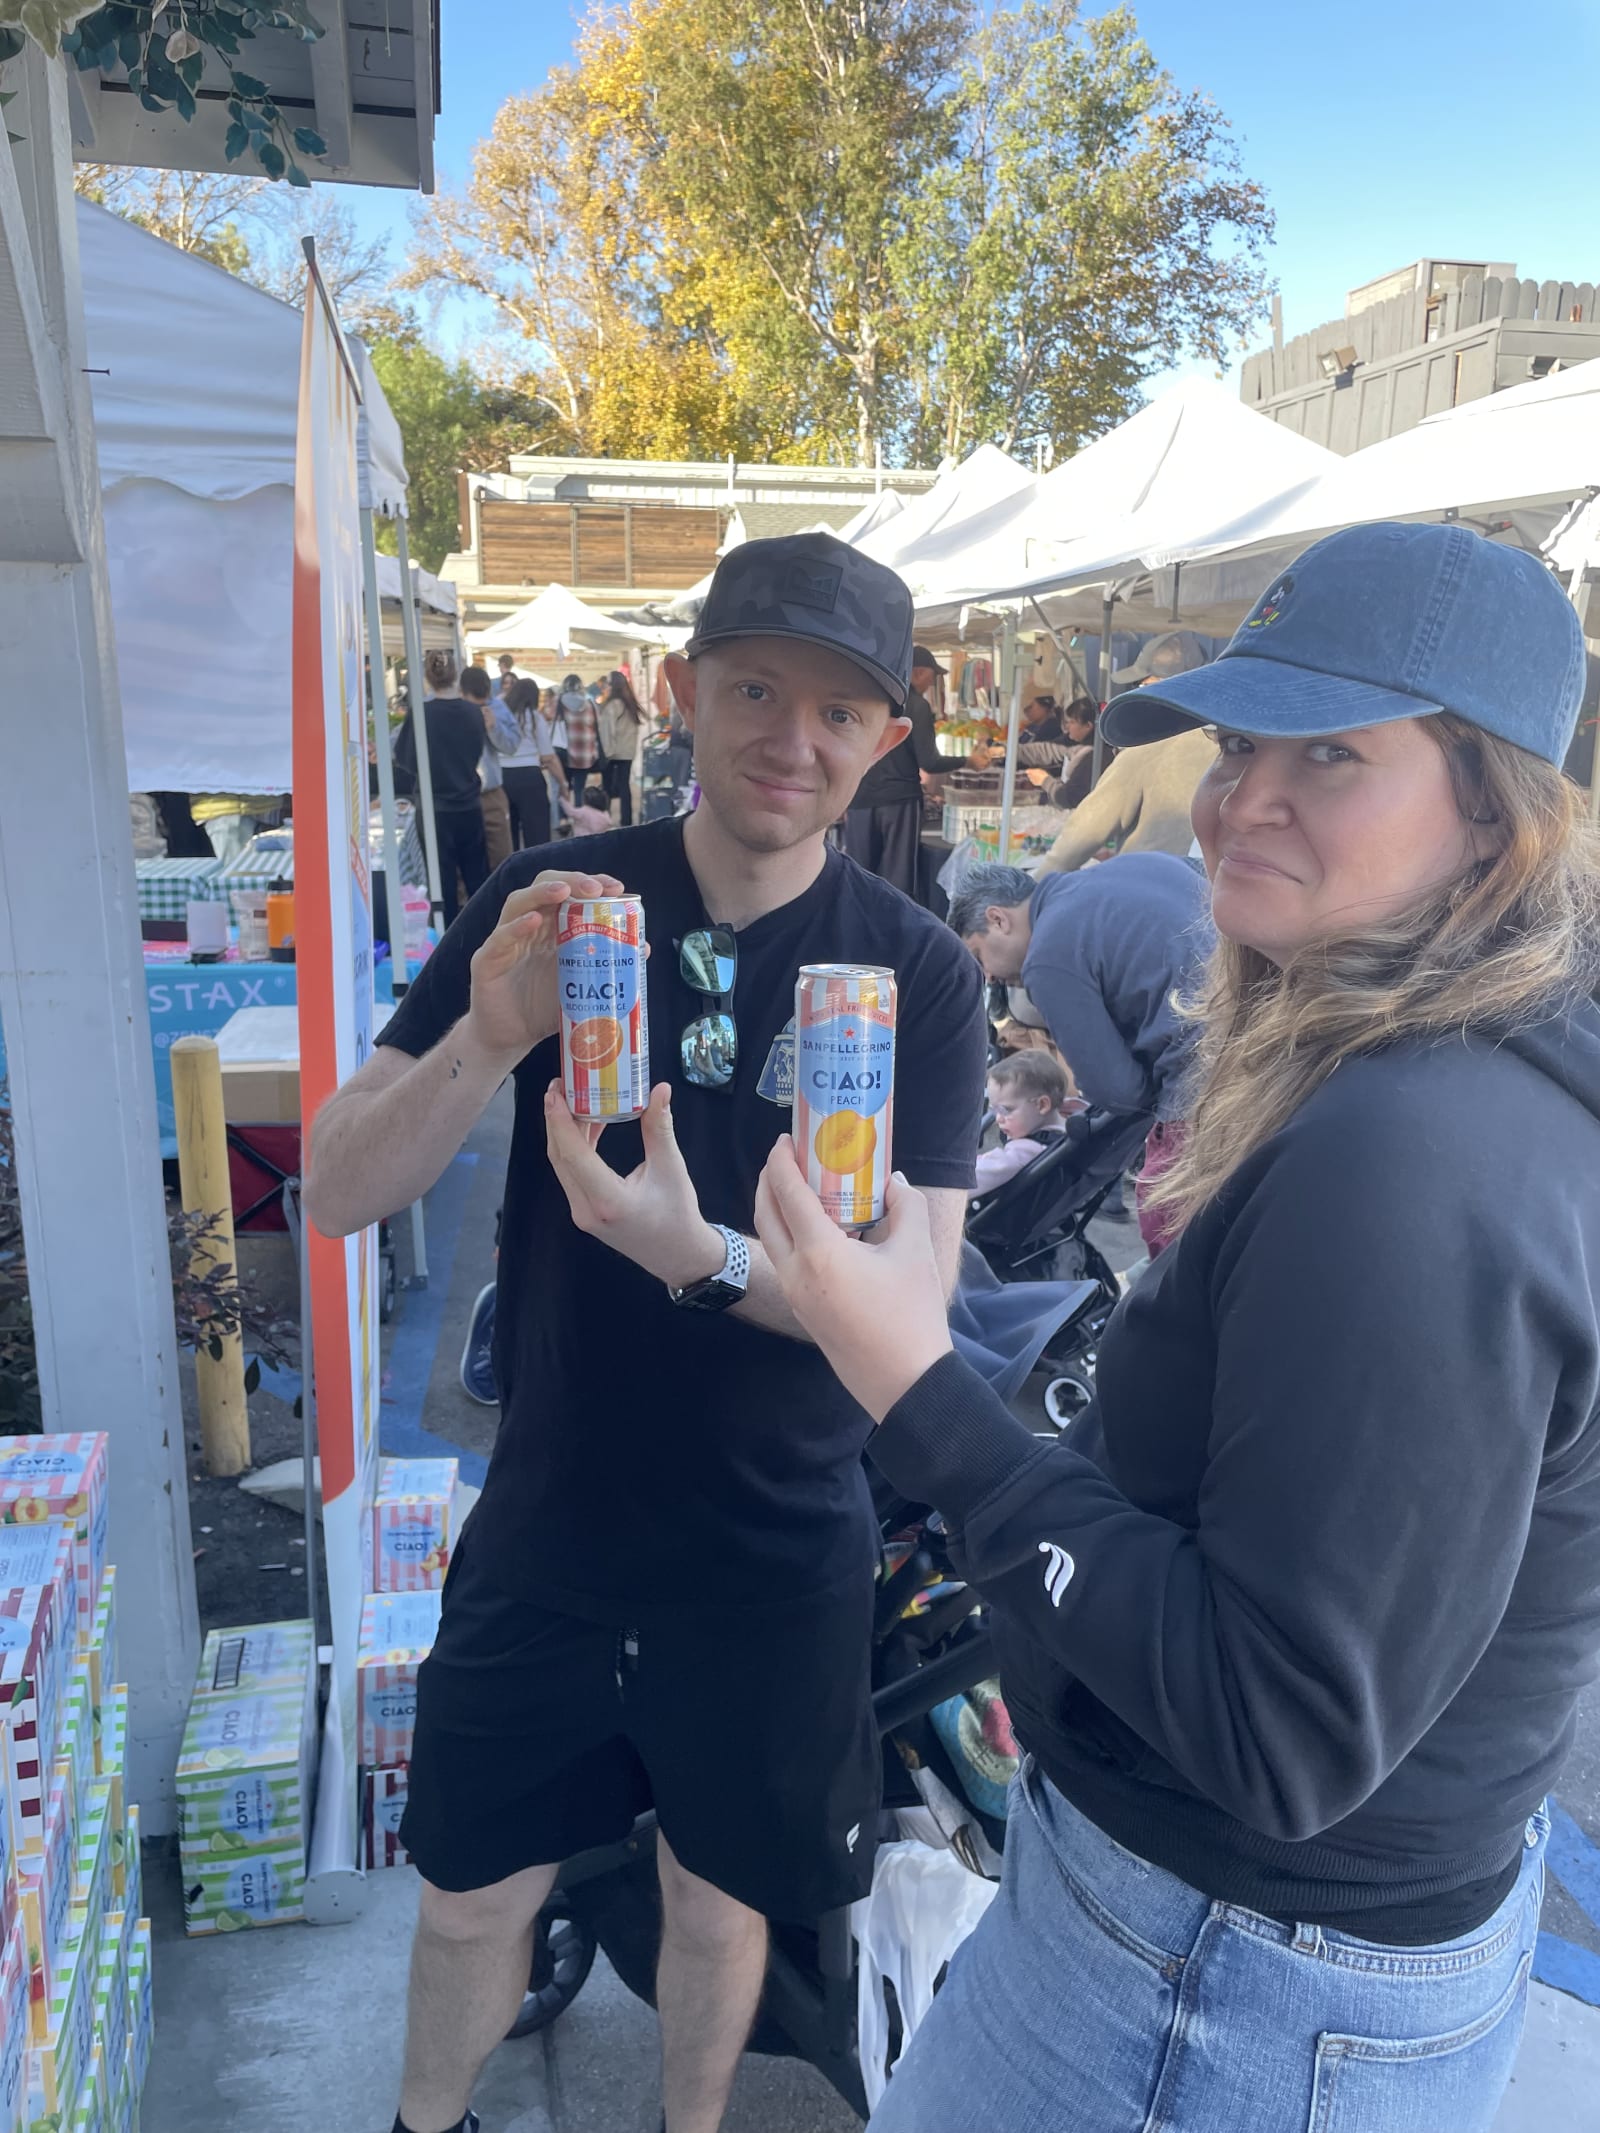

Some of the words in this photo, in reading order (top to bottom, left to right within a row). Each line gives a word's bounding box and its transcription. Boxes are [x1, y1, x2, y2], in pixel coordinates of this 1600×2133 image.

[588, 924, 608, 933] FRUIT
[566, 982, 626, 1000] CIAO!
[592, 1003, 629, 1012] ORAGE
[803, 1040, 891, 1054] SANPELLEGRINO
[812, 1070, 881, 1091] CIAO!
[830, 1096, 865, 1105] PEACH
[381, 1706, 416, 1718] CIAO
[235, 1790, 249, 1830] CIAO!
[241, 1873, 255, 1909] CIAO!
